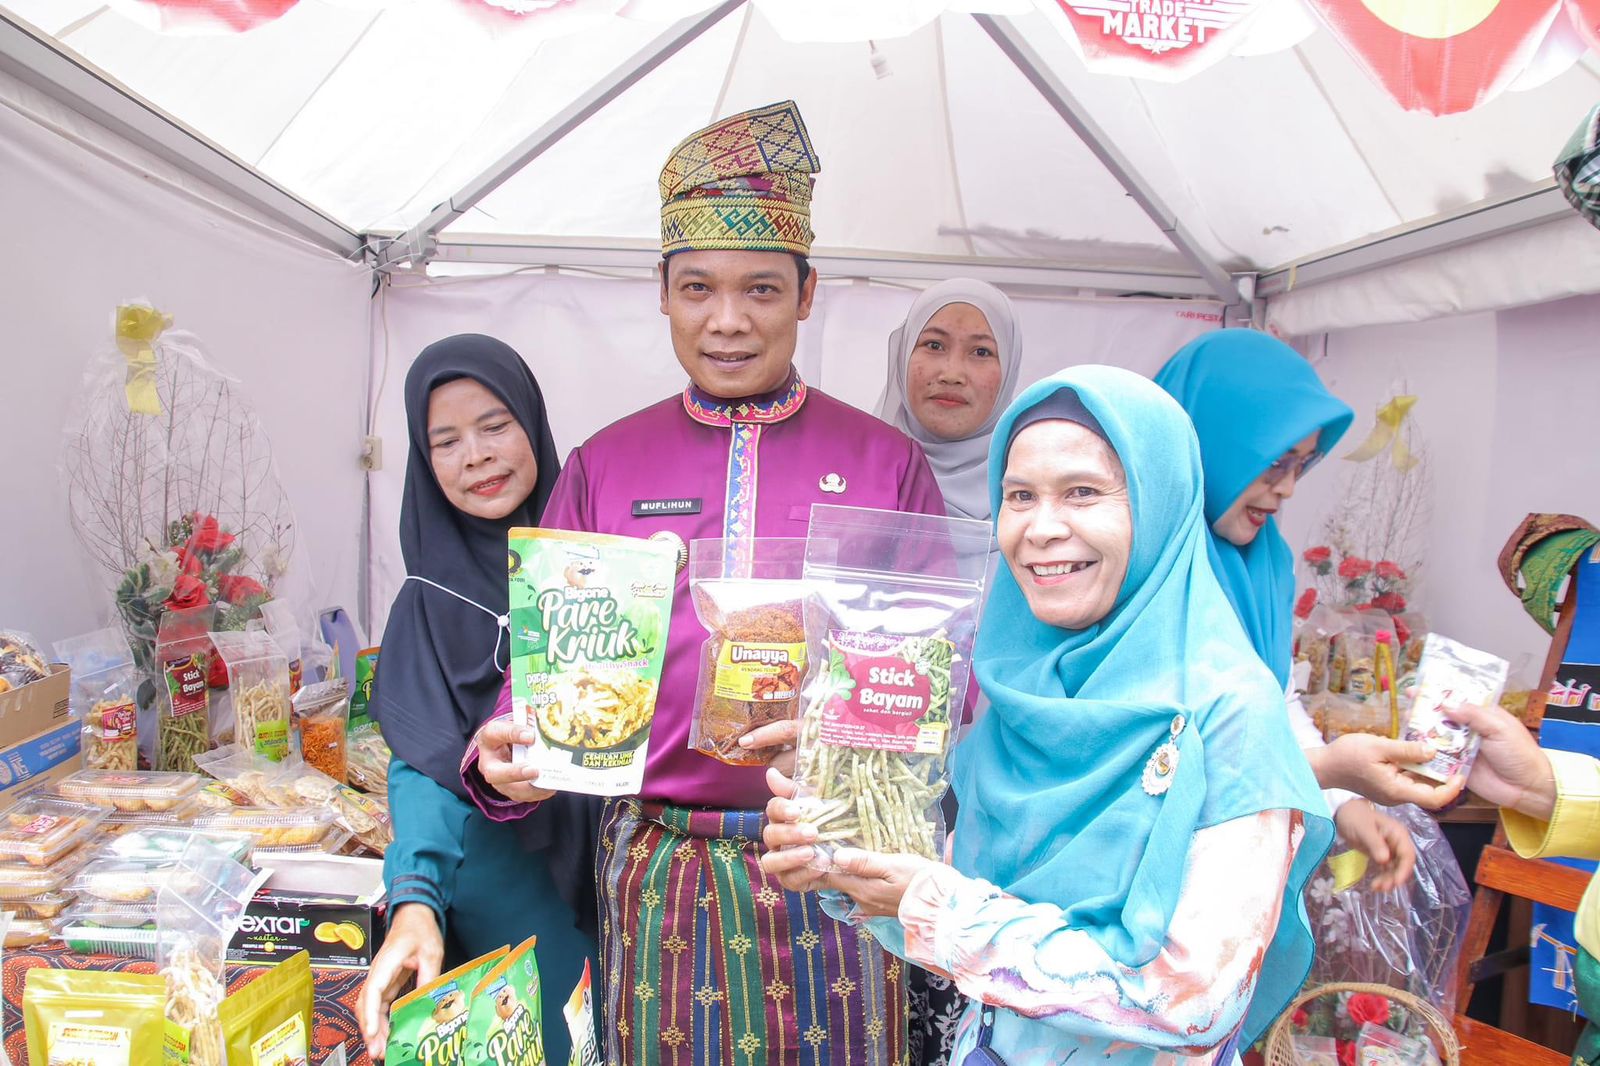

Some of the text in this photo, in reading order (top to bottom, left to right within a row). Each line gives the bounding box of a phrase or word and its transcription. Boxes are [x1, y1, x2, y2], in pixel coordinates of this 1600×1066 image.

[1130, 0, 1186, 16] TRADE
[1103, 10, 1209, 43] MARKET
[641, 501, 692, 510] MUFLIHUN
[564, 587, 610, 602] Bigone
[538, 590, 615, 633] Pare
[548, 621, 636, 664] Kriuk
[622, 657, 649, 668] Snack
[731, 646, 788, 666] Unayya
[183, 671, 200, 682] Stick
[869, 667, 915, 687] Stick
[860, 688, 923, 710] Bayam
[436, 1010, 469, 1039] Bigon
[417, 1026, 468, 1066] Par
